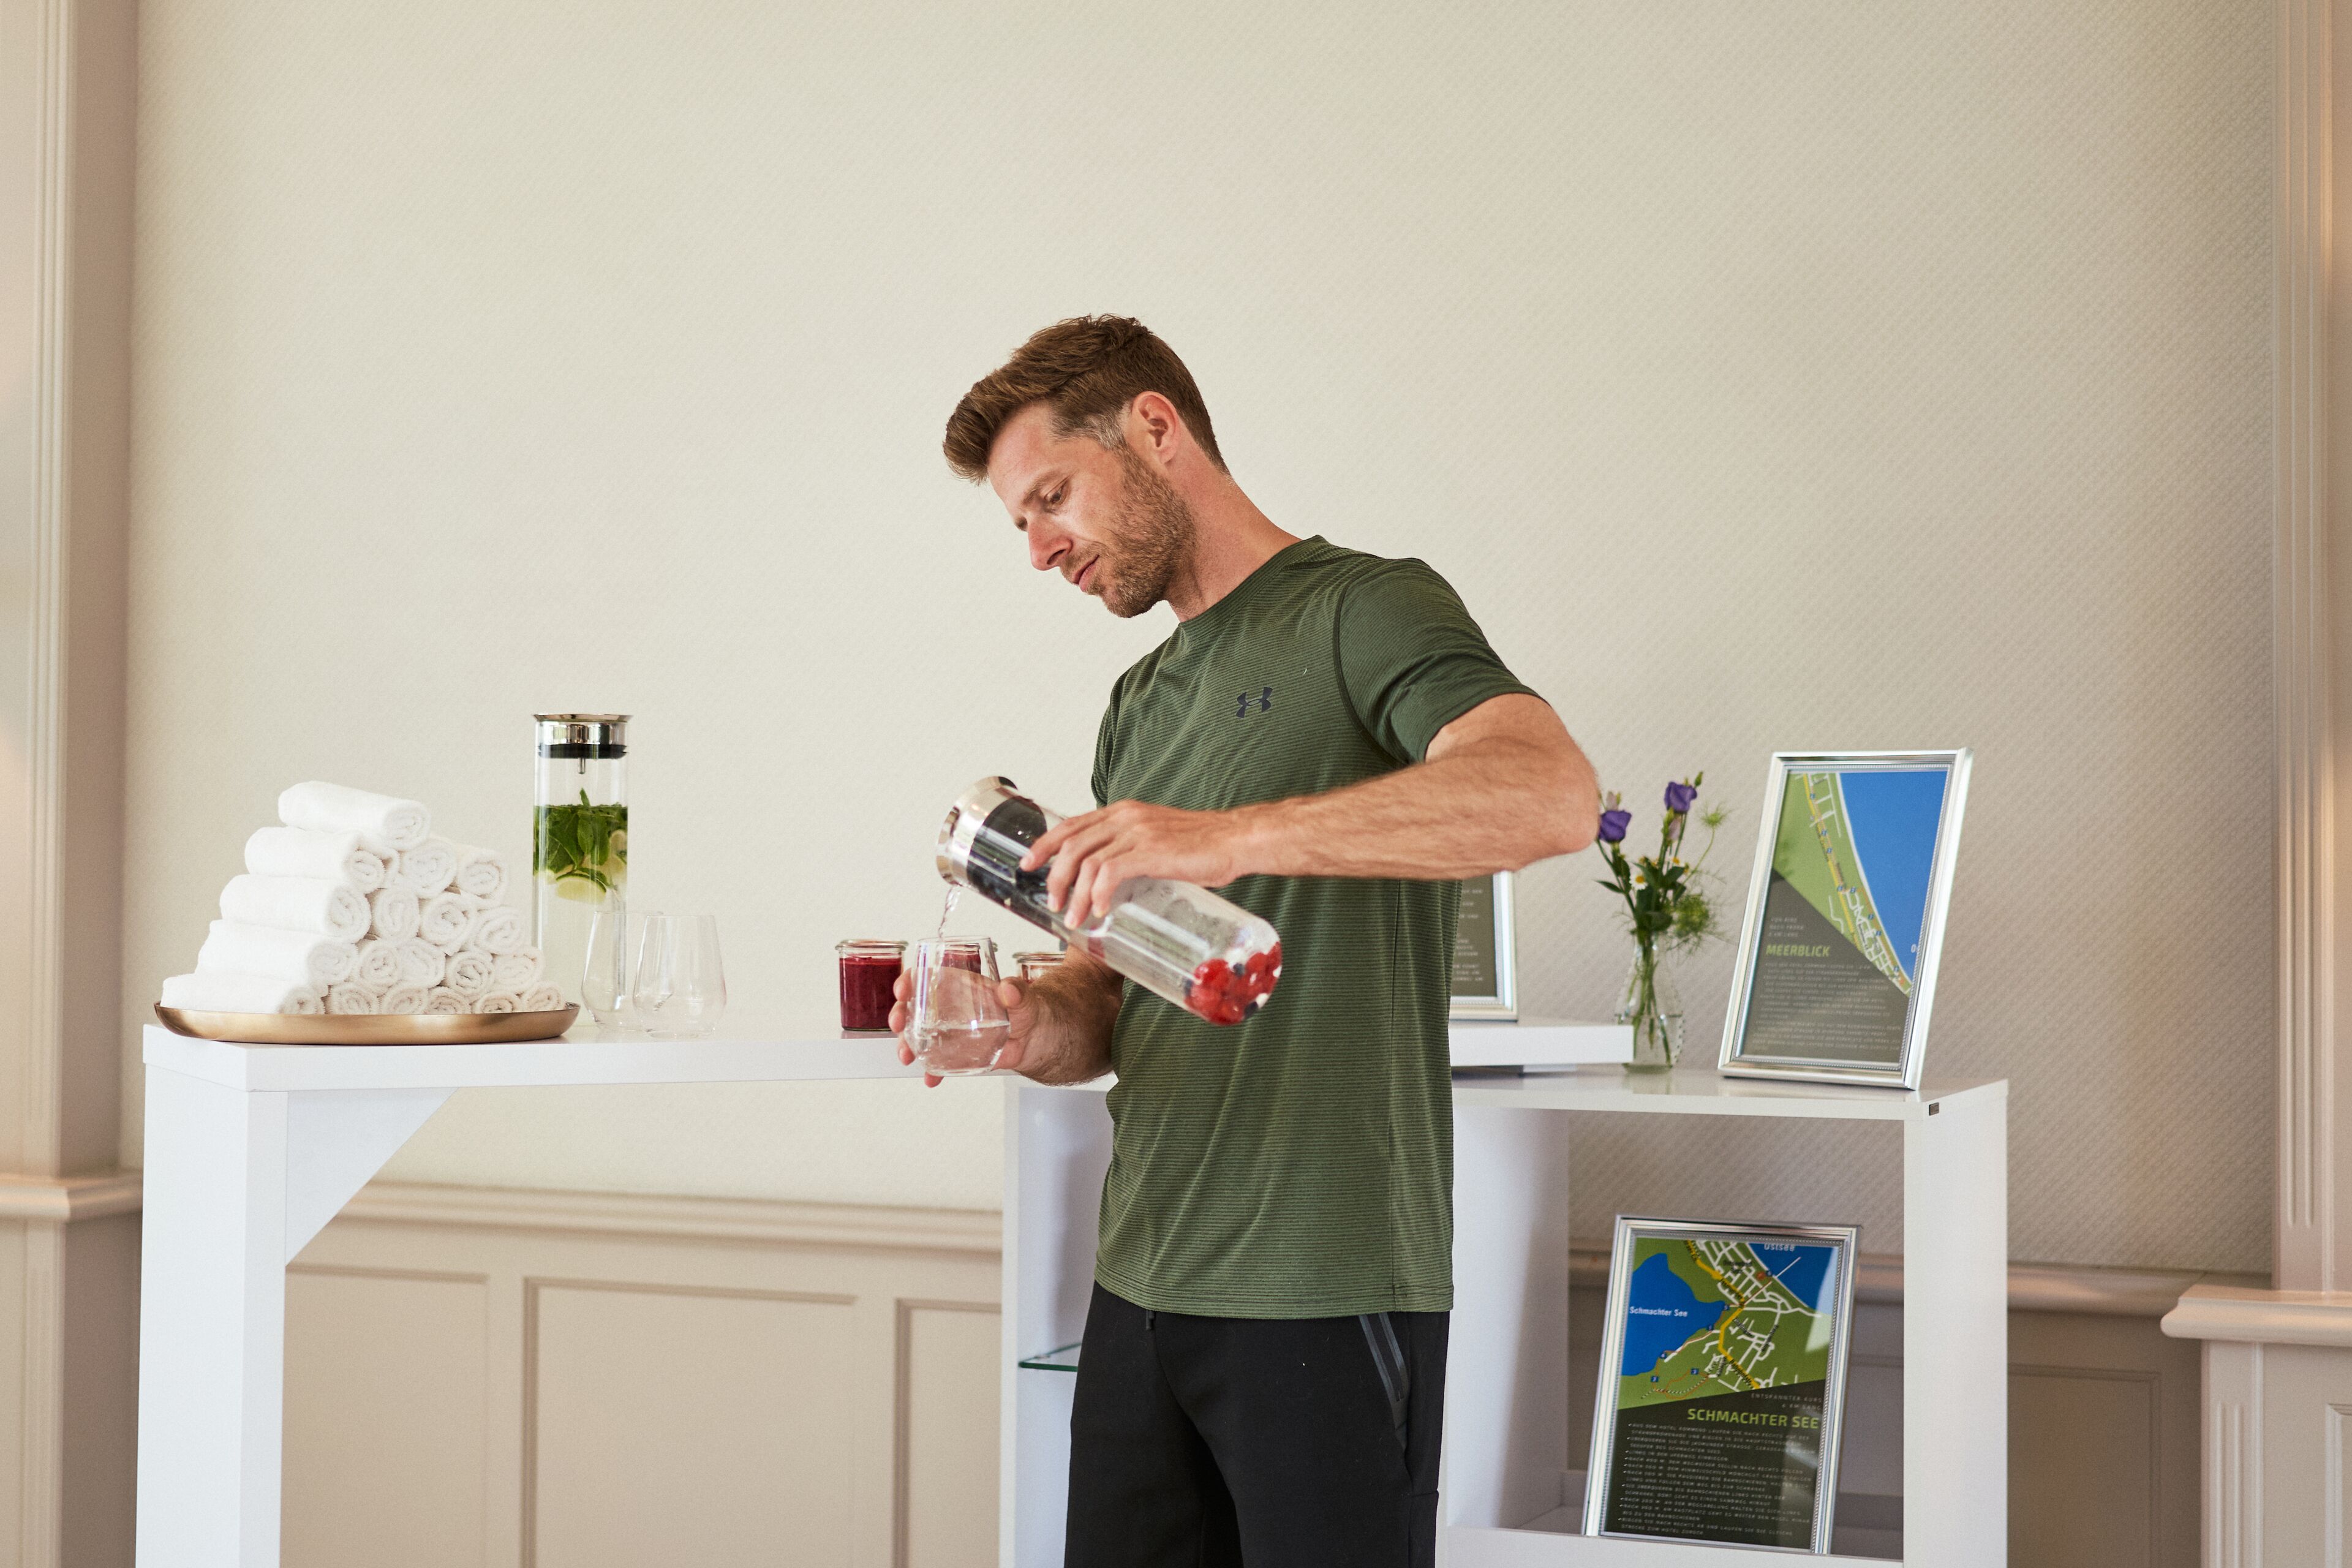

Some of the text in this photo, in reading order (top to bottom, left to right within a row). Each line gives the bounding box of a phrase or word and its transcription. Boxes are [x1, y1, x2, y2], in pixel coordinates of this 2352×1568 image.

[1766, 944, 1830, 957] MEERBLICK
[1629, 1306, 1688, 1317] Schmachter See
[1687, 1408, 1819, 1430] SCHMACHTER SEE
